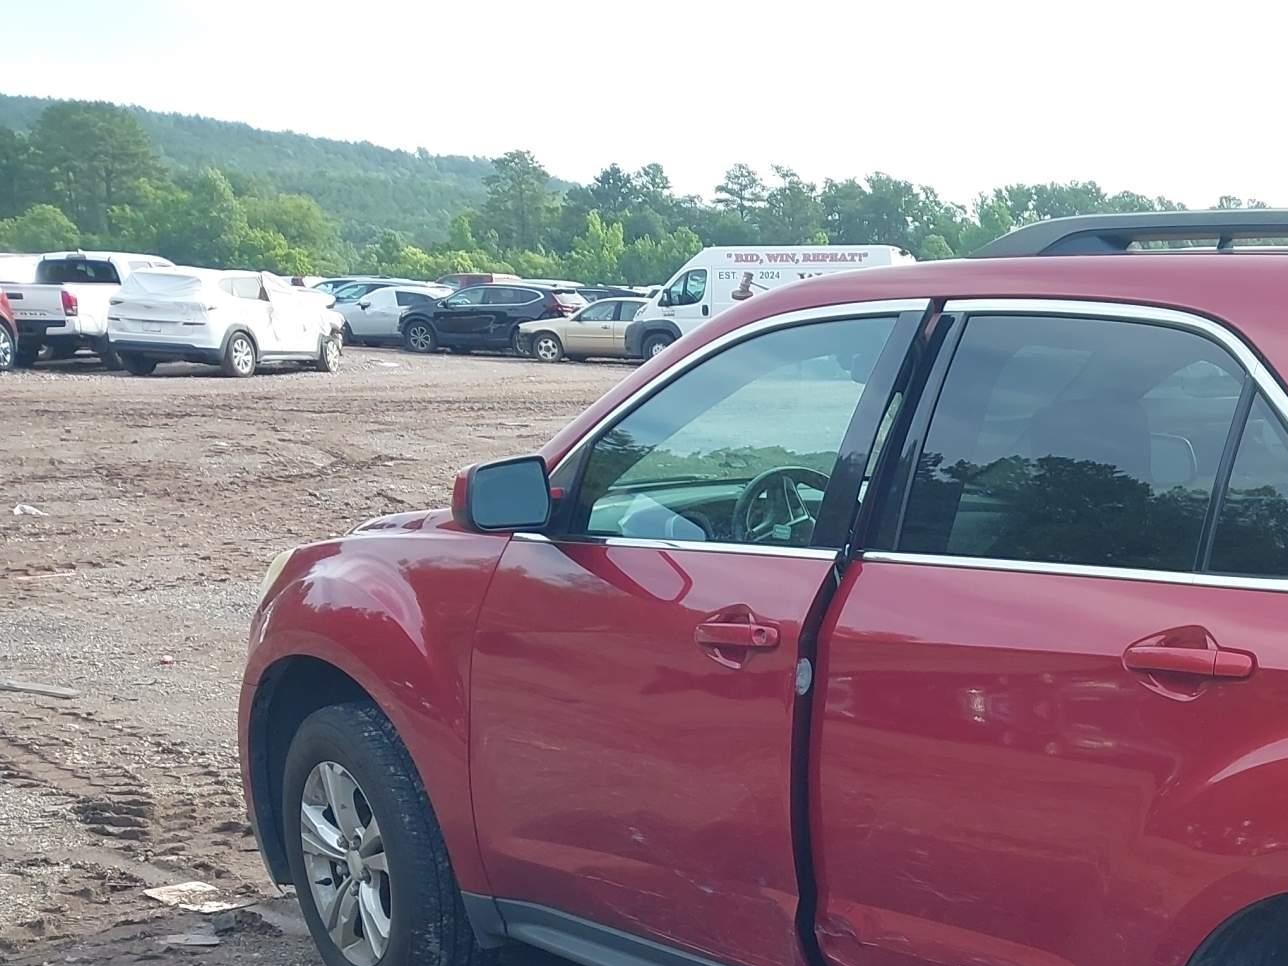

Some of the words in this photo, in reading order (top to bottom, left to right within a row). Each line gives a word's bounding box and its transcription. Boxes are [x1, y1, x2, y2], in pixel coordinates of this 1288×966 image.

[766, 253, 800, 264] WIN,
[718, 271, 738, 280] EST.
[759, 271, 780, 280] 2024
